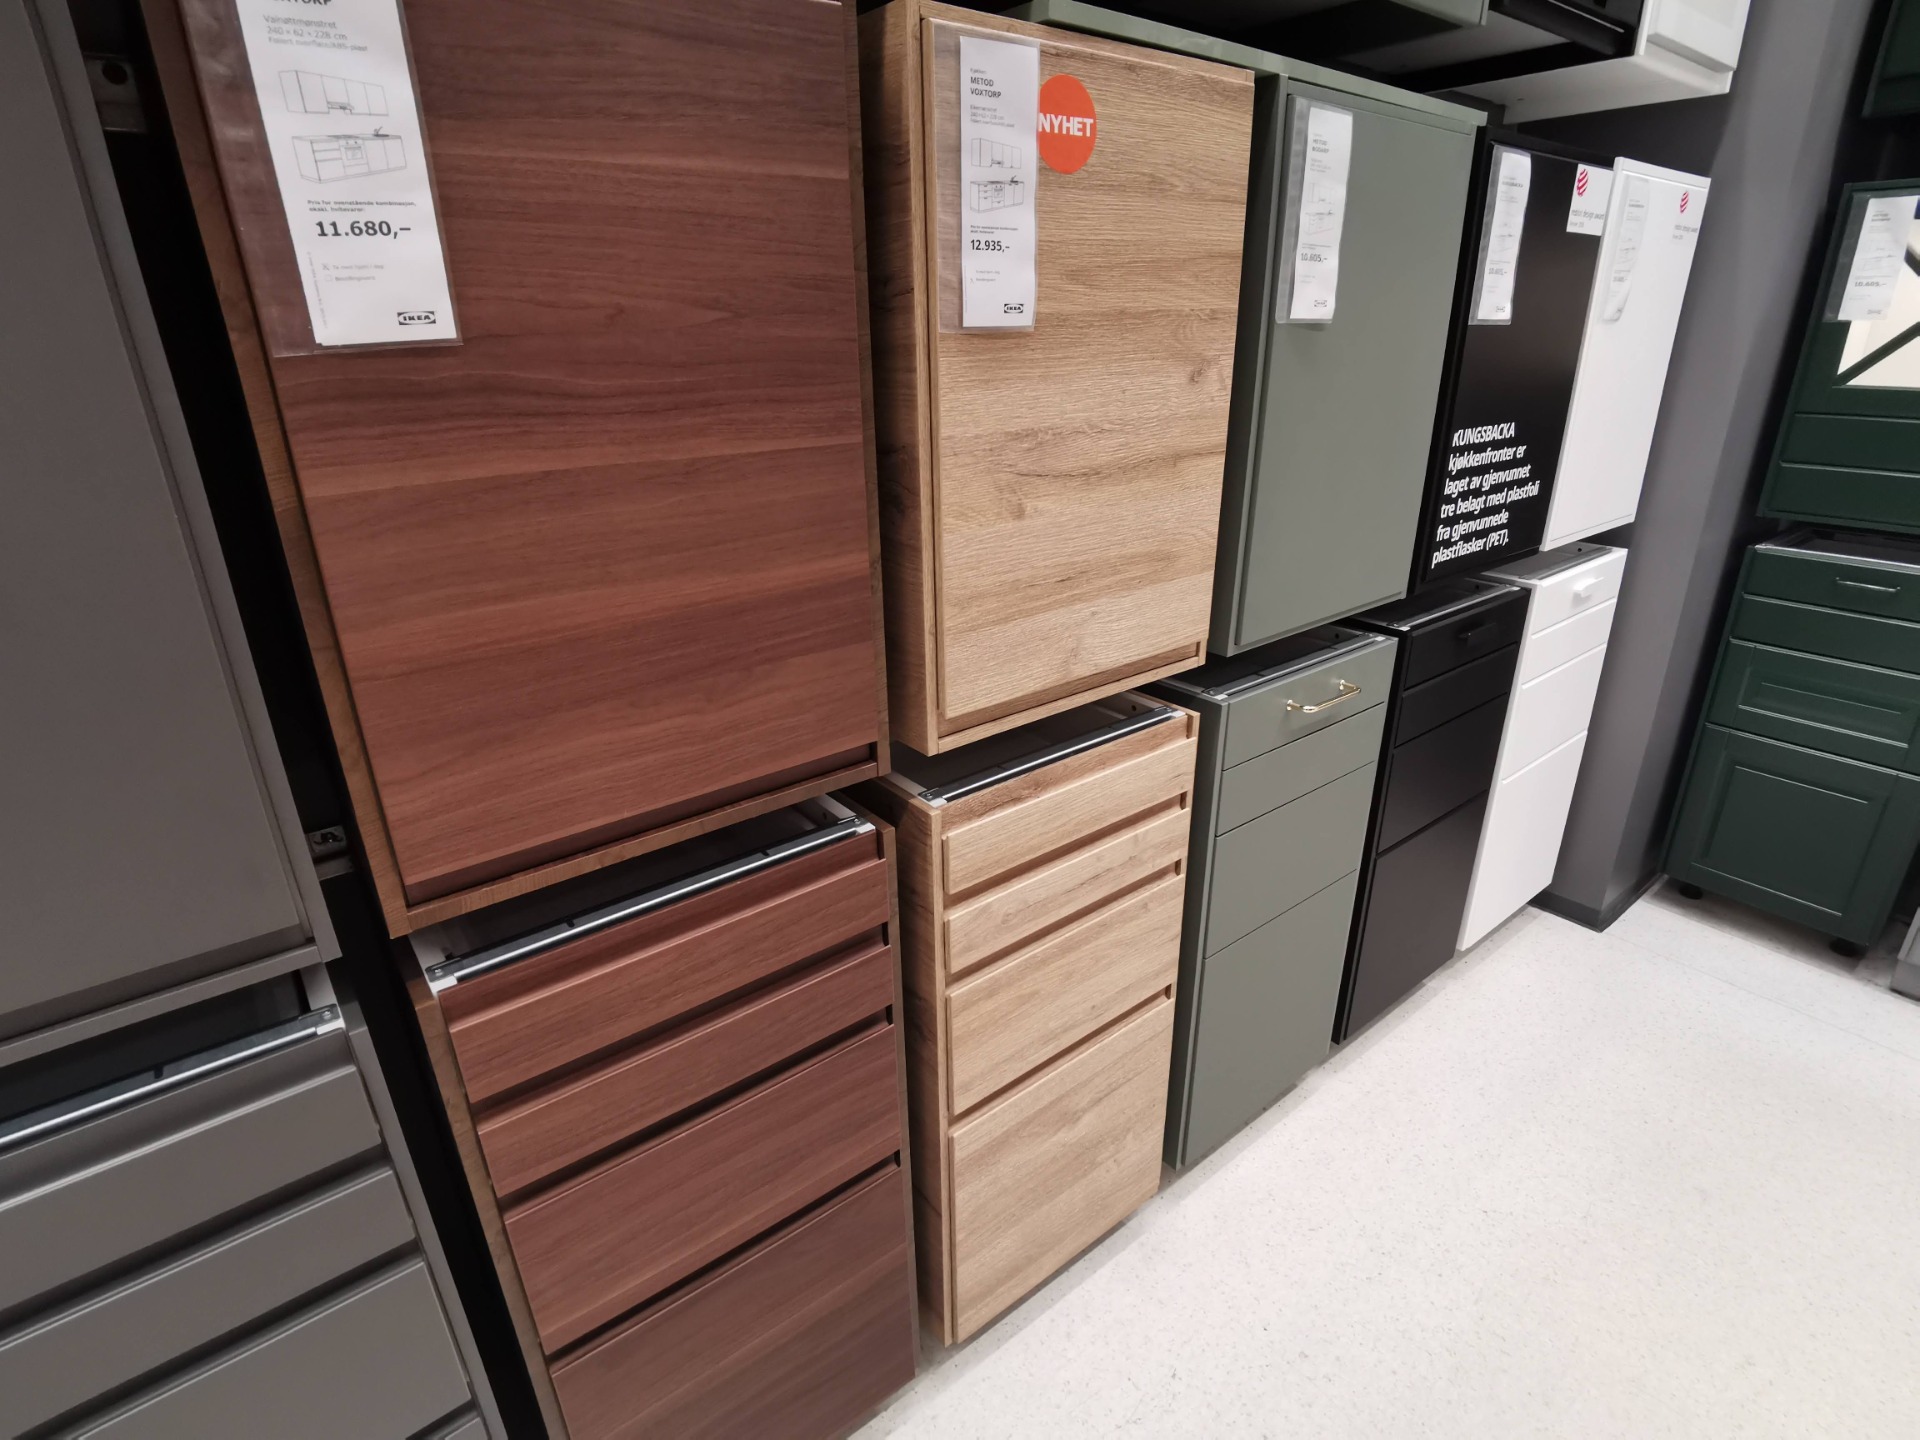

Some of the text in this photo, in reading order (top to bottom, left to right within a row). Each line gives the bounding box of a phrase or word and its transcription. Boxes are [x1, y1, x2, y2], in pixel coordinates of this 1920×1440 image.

[970, 76, 994, 87] METOD
[970, 87, 1002, 98] VOXTORP
[1039, 112, 1094, 137] NYHET
[1452, 422, 1515, 447] KUNGSBACKA
[1449, 445, 1527, 475] kjøkkenfronter er
[1444, 464, 1531, 498] laget av gjenvunnet
[1441, 481, 1540, 518] tre belagt med plastfoli
[1436, 509, 1509, 541] fra gjenvunnede
[1431, 529, 1509, 569] plastflasker (PET).
